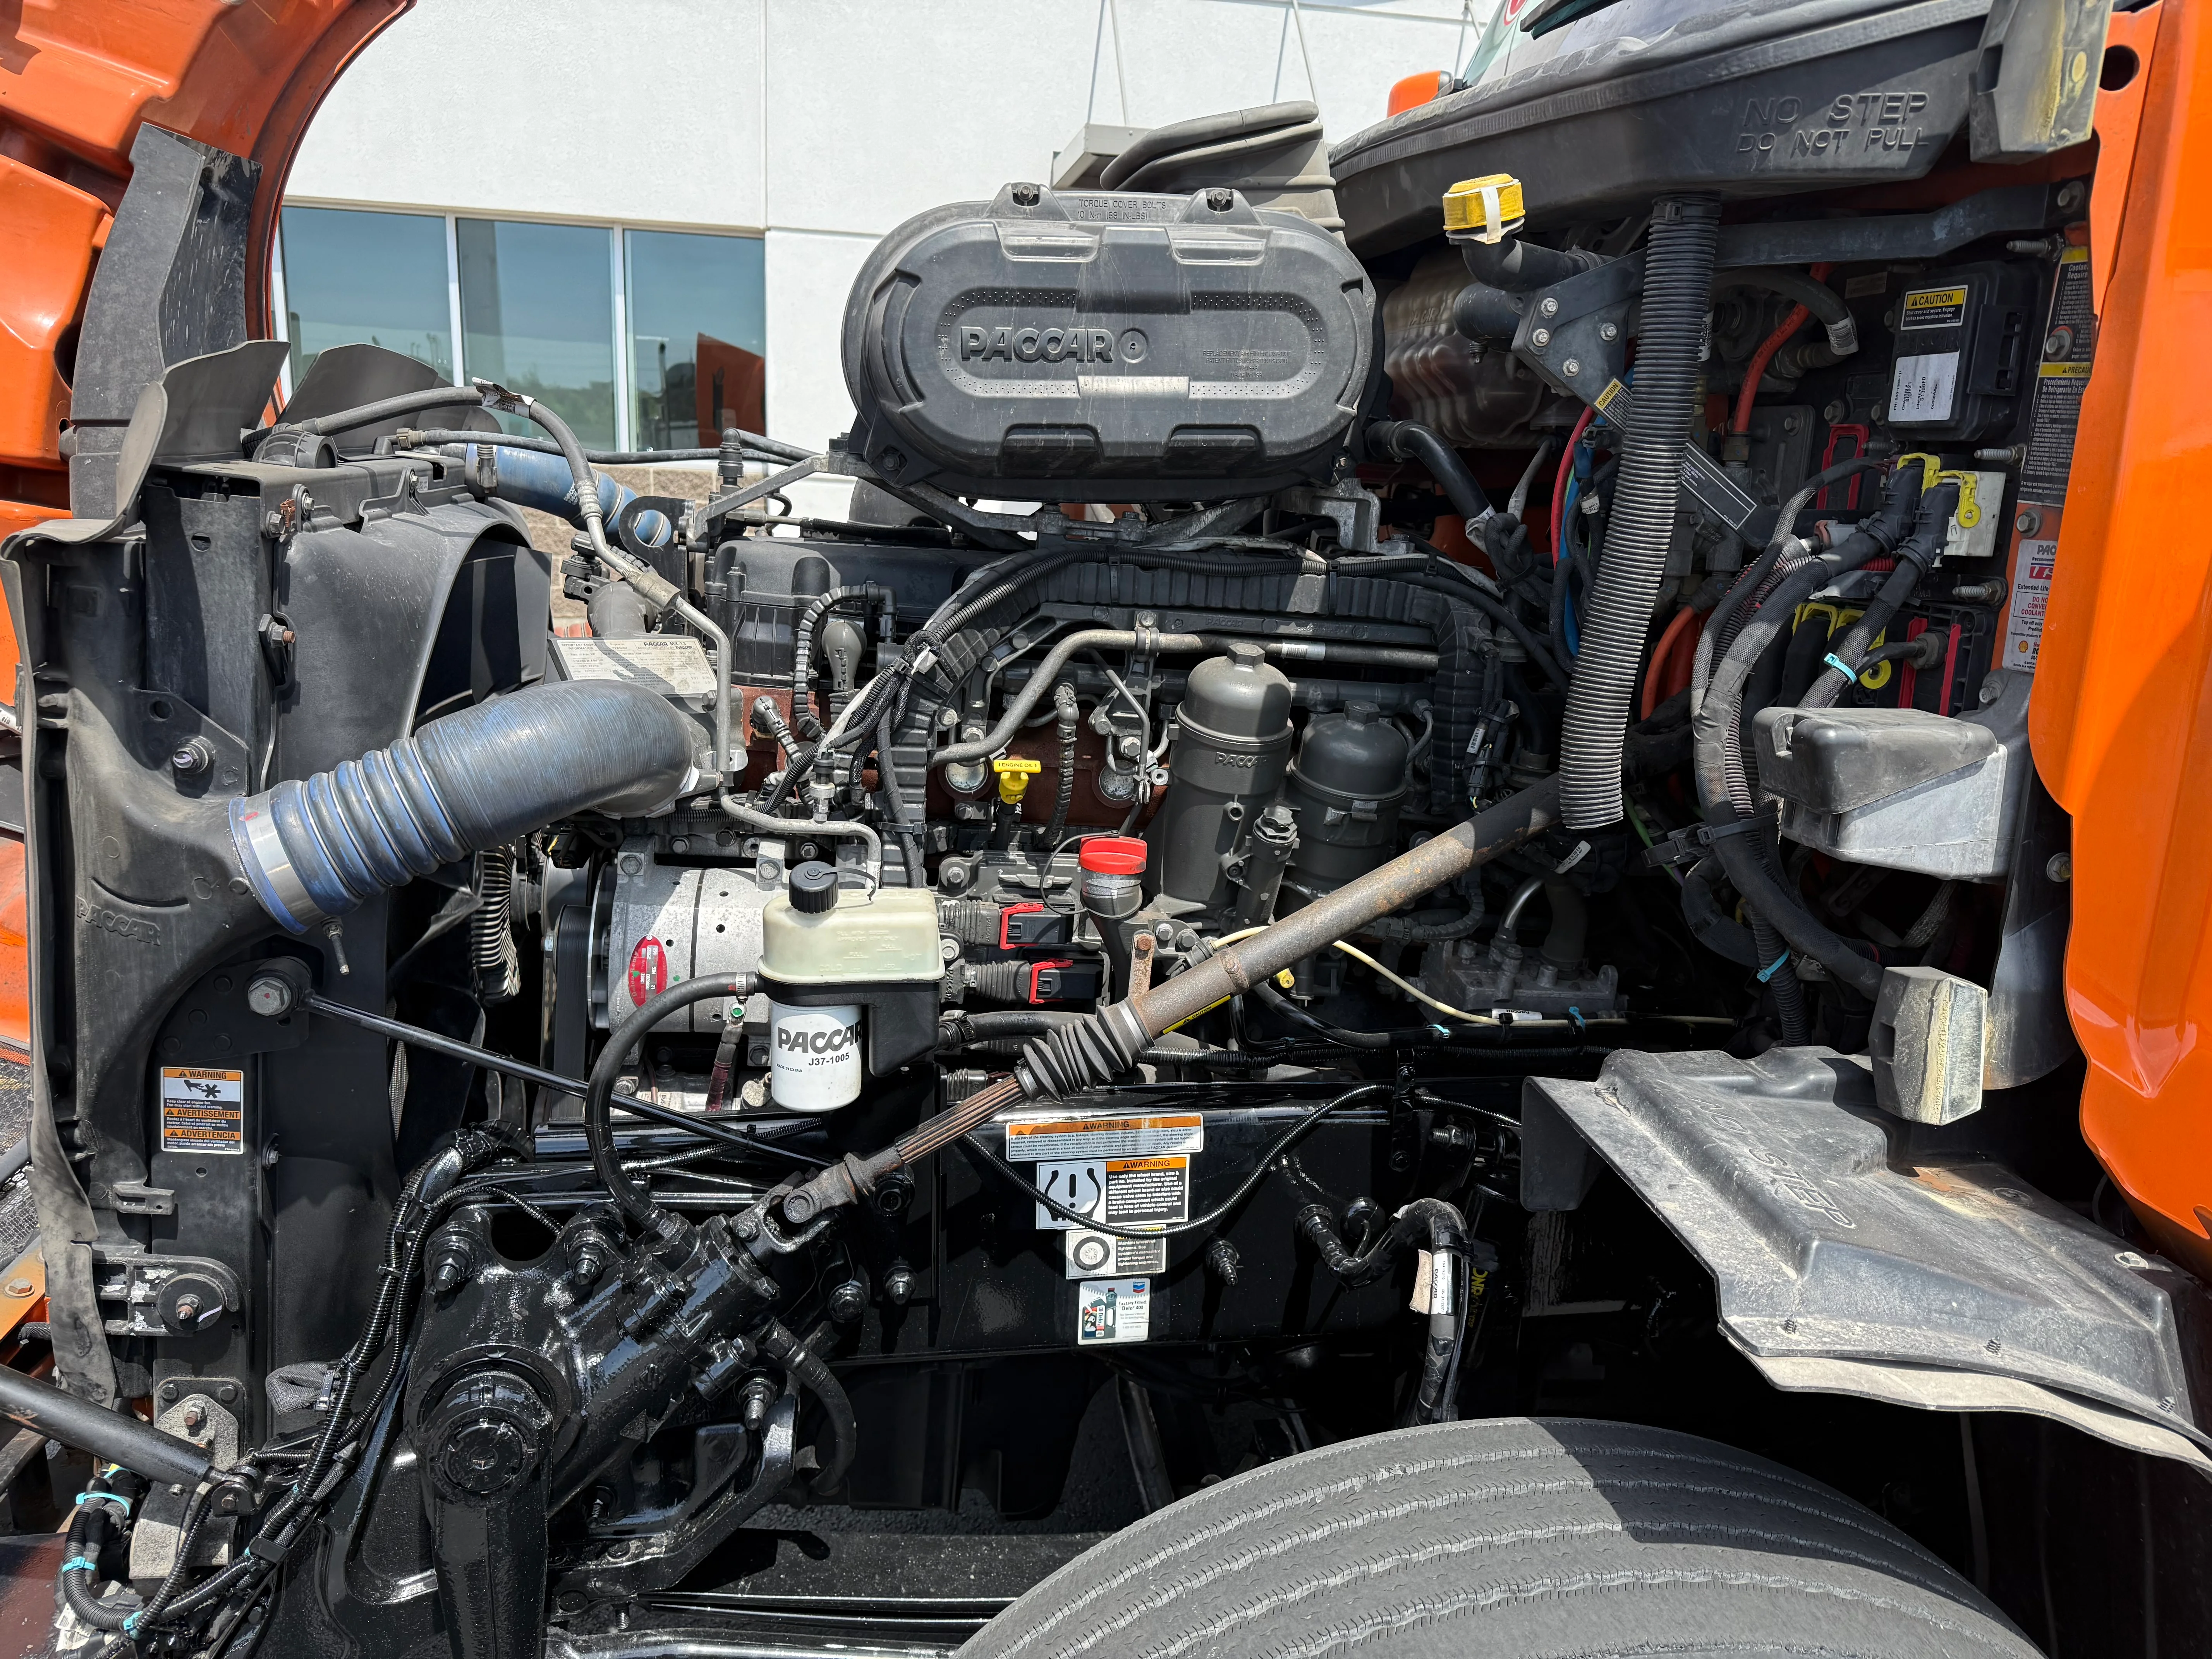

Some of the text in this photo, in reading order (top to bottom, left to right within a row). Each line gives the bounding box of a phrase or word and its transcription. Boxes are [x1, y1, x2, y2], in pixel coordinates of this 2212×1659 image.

[1744, 92, 1929, 126] NO STEP
[1737, 127, 1929, 153] DO NOT PULL
[1079, 199, 1108, 208] TORQUE
[1113, 200, 1137, 209] COVER
[1919, 293, 1953, 306] CAUTION
[961, 326, 1113, 363] PACCAR
[1599, 383, 1619, 406] CAUTION
[2048, 386, 2071, 394] Refrigerante
[2037, 544, 2056, 555] PAC
[1205, 616, 1244, 628] PACCAR
[1215, 752, 1268, 768] PACCAR
[75, 895, 161, 946] PACCAR
[1192, 1006, 1212, 1018] CAUTION
[778, 1019, 862, 1054] PACCAR
[809, 1052, 849, 1066] J37-1005
[189, 1070, 227, 1079] WARNING
[177, 1109, 239, 1118] AVERTISSEMENT
[1090, 1121, 1129, 1129] WARNING
[181, 1130, 235, 1139] ADVERTENCIA
[1687, 1096, 1855, 1228] NO STEP
